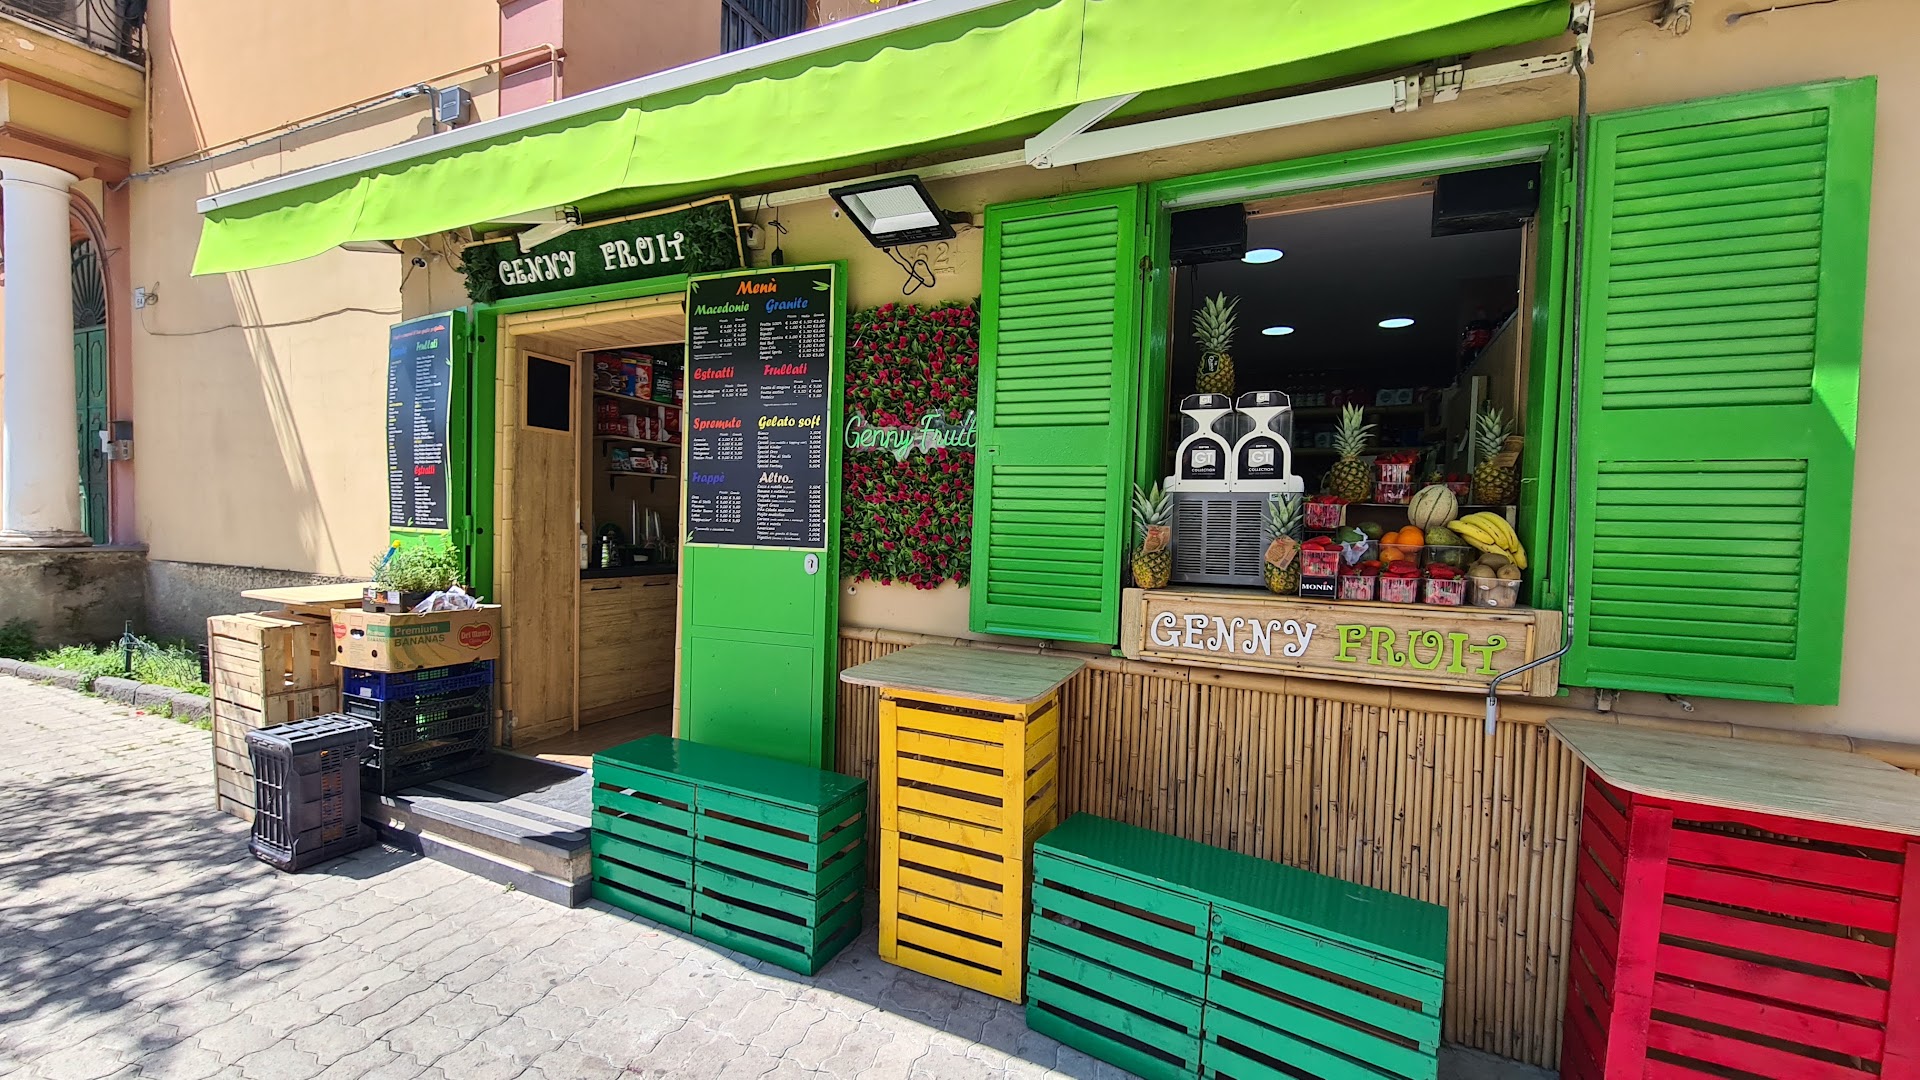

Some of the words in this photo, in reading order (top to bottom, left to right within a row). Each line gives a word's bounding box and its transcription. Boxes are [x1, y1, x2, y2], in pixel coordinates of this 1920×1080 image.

[499, 251, 576, 286] GENNY
[600, 231, 685, 271] FRUIT
[736, 277, 777, 295] Menù
[694, 301, 750, 316] Macedonie
[765, 297, 808, 314] Granite
[694, 366, 734, 380] Estratti
[763, 363, 807, 376] Frullati
[693, 417, 742, 431] Spremute
[758, 415, 796, 430] Gelato
[798, 415, 821, 429] soft
[845, 415, 914, 458] Genny
[1194, 451, 1214, 464] GT
[1252, 450, 1272, 463] GT
[1301, 582, 1334, 591] MONIN
[394, 625, 438, 636] Premium
[394, 635, 446, 648] BANANAS
[1150, 611, 1317, 657] GENNY
[1334, 624, 1508, 675] FRUIT
